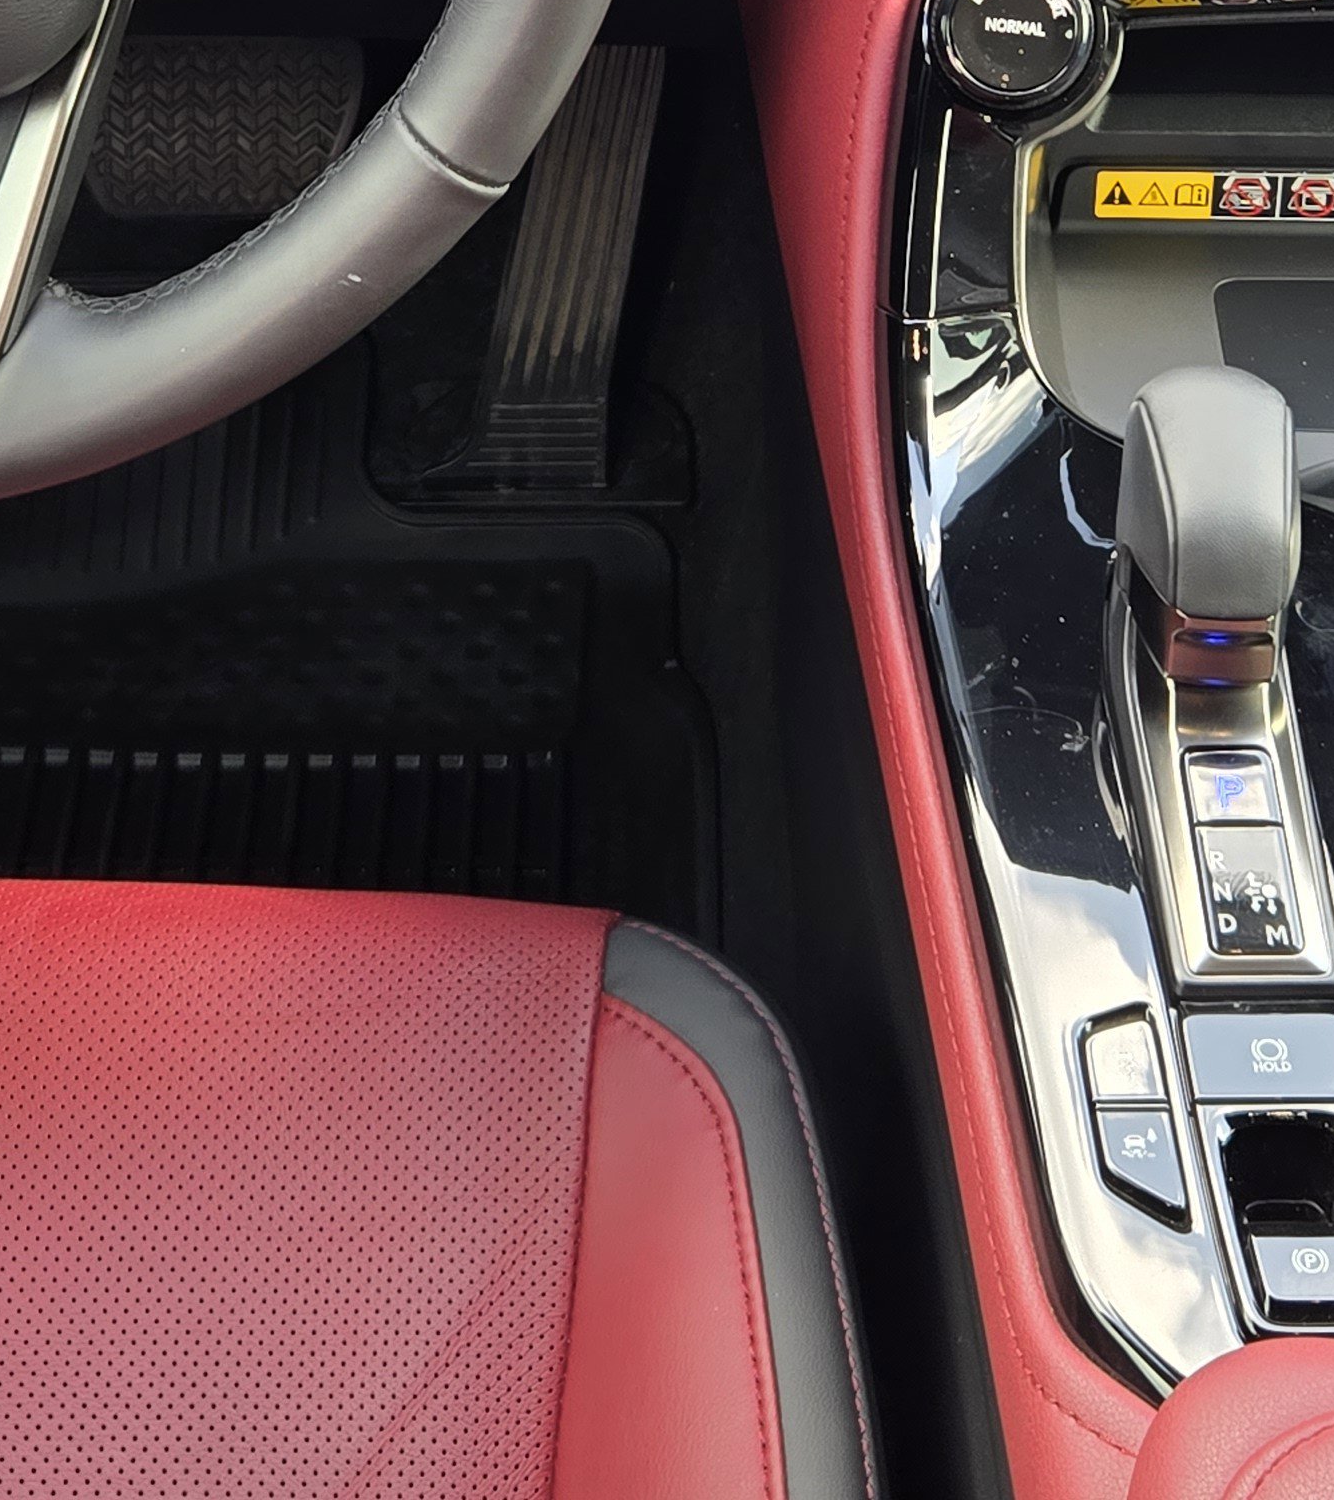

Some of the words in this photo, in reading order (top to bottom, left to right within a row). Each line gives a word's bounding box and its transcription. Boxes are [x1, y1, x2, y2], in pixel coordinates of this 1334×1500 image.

[984, 16, 1046, 37] NORMAL
[1216, 773, 1245, 809] P
[1209, 850, 1228, 871] R
[1212, 880, 1233, 903] N
[1217, 913, 1238, 934] D
[1265, 924, 1290, 947] M
[1252, 1060, 1292, 1073] HOLD
